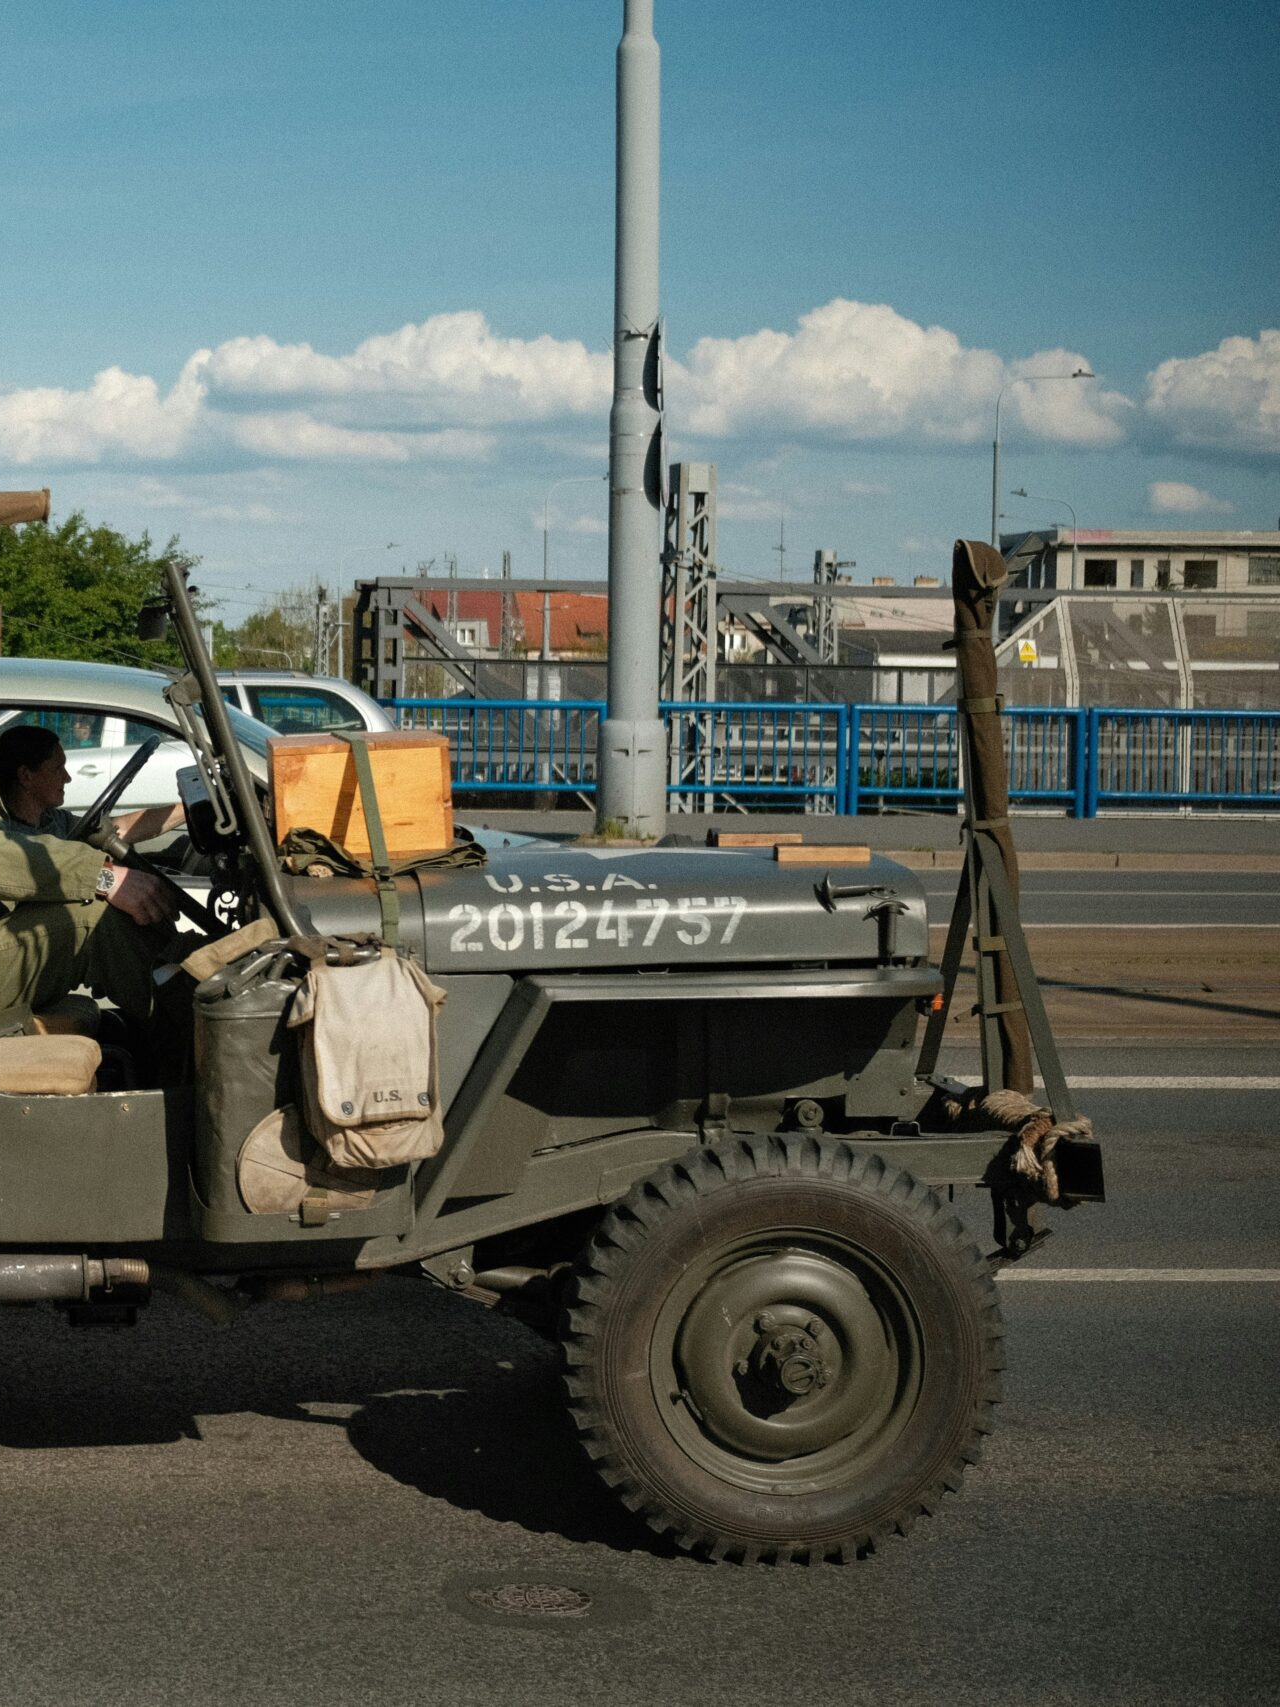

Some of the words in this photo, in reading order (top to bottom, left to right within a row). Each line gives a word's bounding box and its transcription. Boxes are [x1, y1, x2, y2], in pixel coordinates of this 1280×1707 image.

[484, 873, 658, 893] U.S.A.
[448, 896, 748, 951] 20124757
[373, 1090, 402, 1103] U.S.
